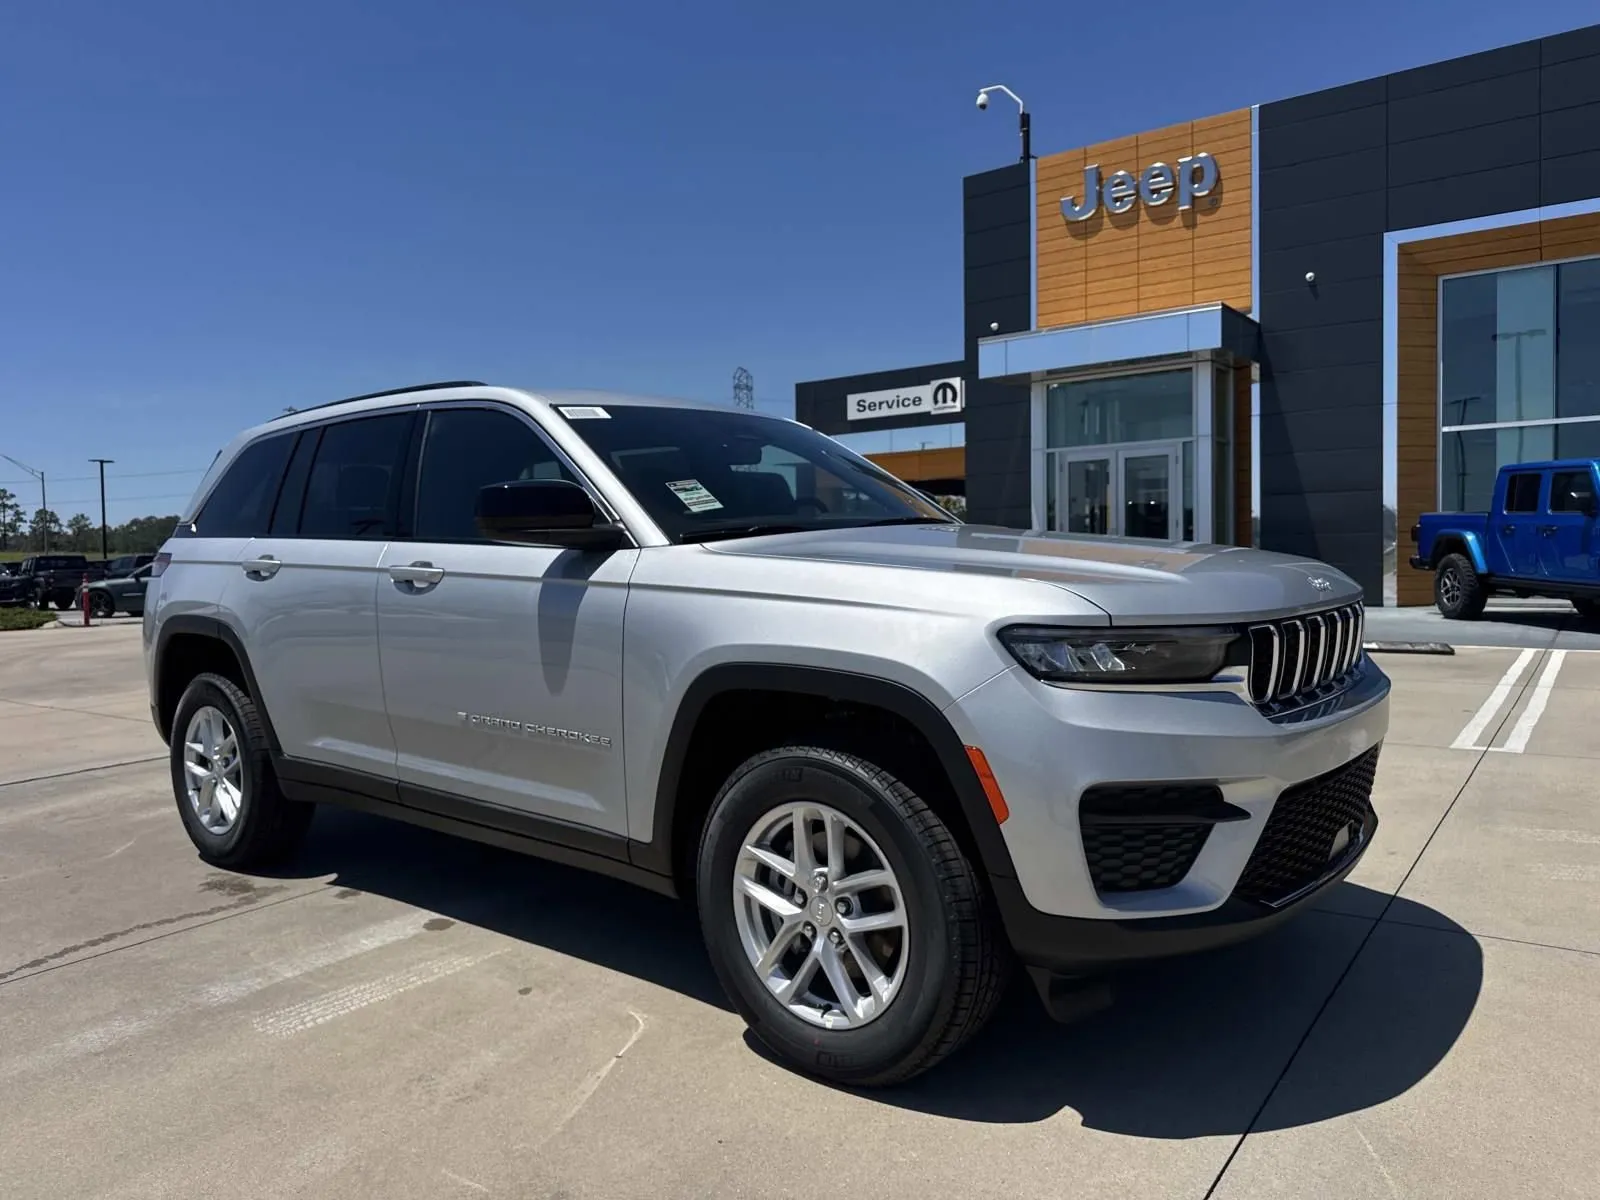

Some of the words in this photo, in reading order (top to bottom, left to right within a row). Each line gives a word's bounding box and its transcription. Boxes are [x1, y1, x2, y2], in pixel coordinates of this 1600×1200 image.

[1060, 152, 1218, 221] Jeep
[856, 395, 922, 412] Service
[471, 714, 521, 729] GRAND
[525, 723, 611, 746] CHEROKEE
